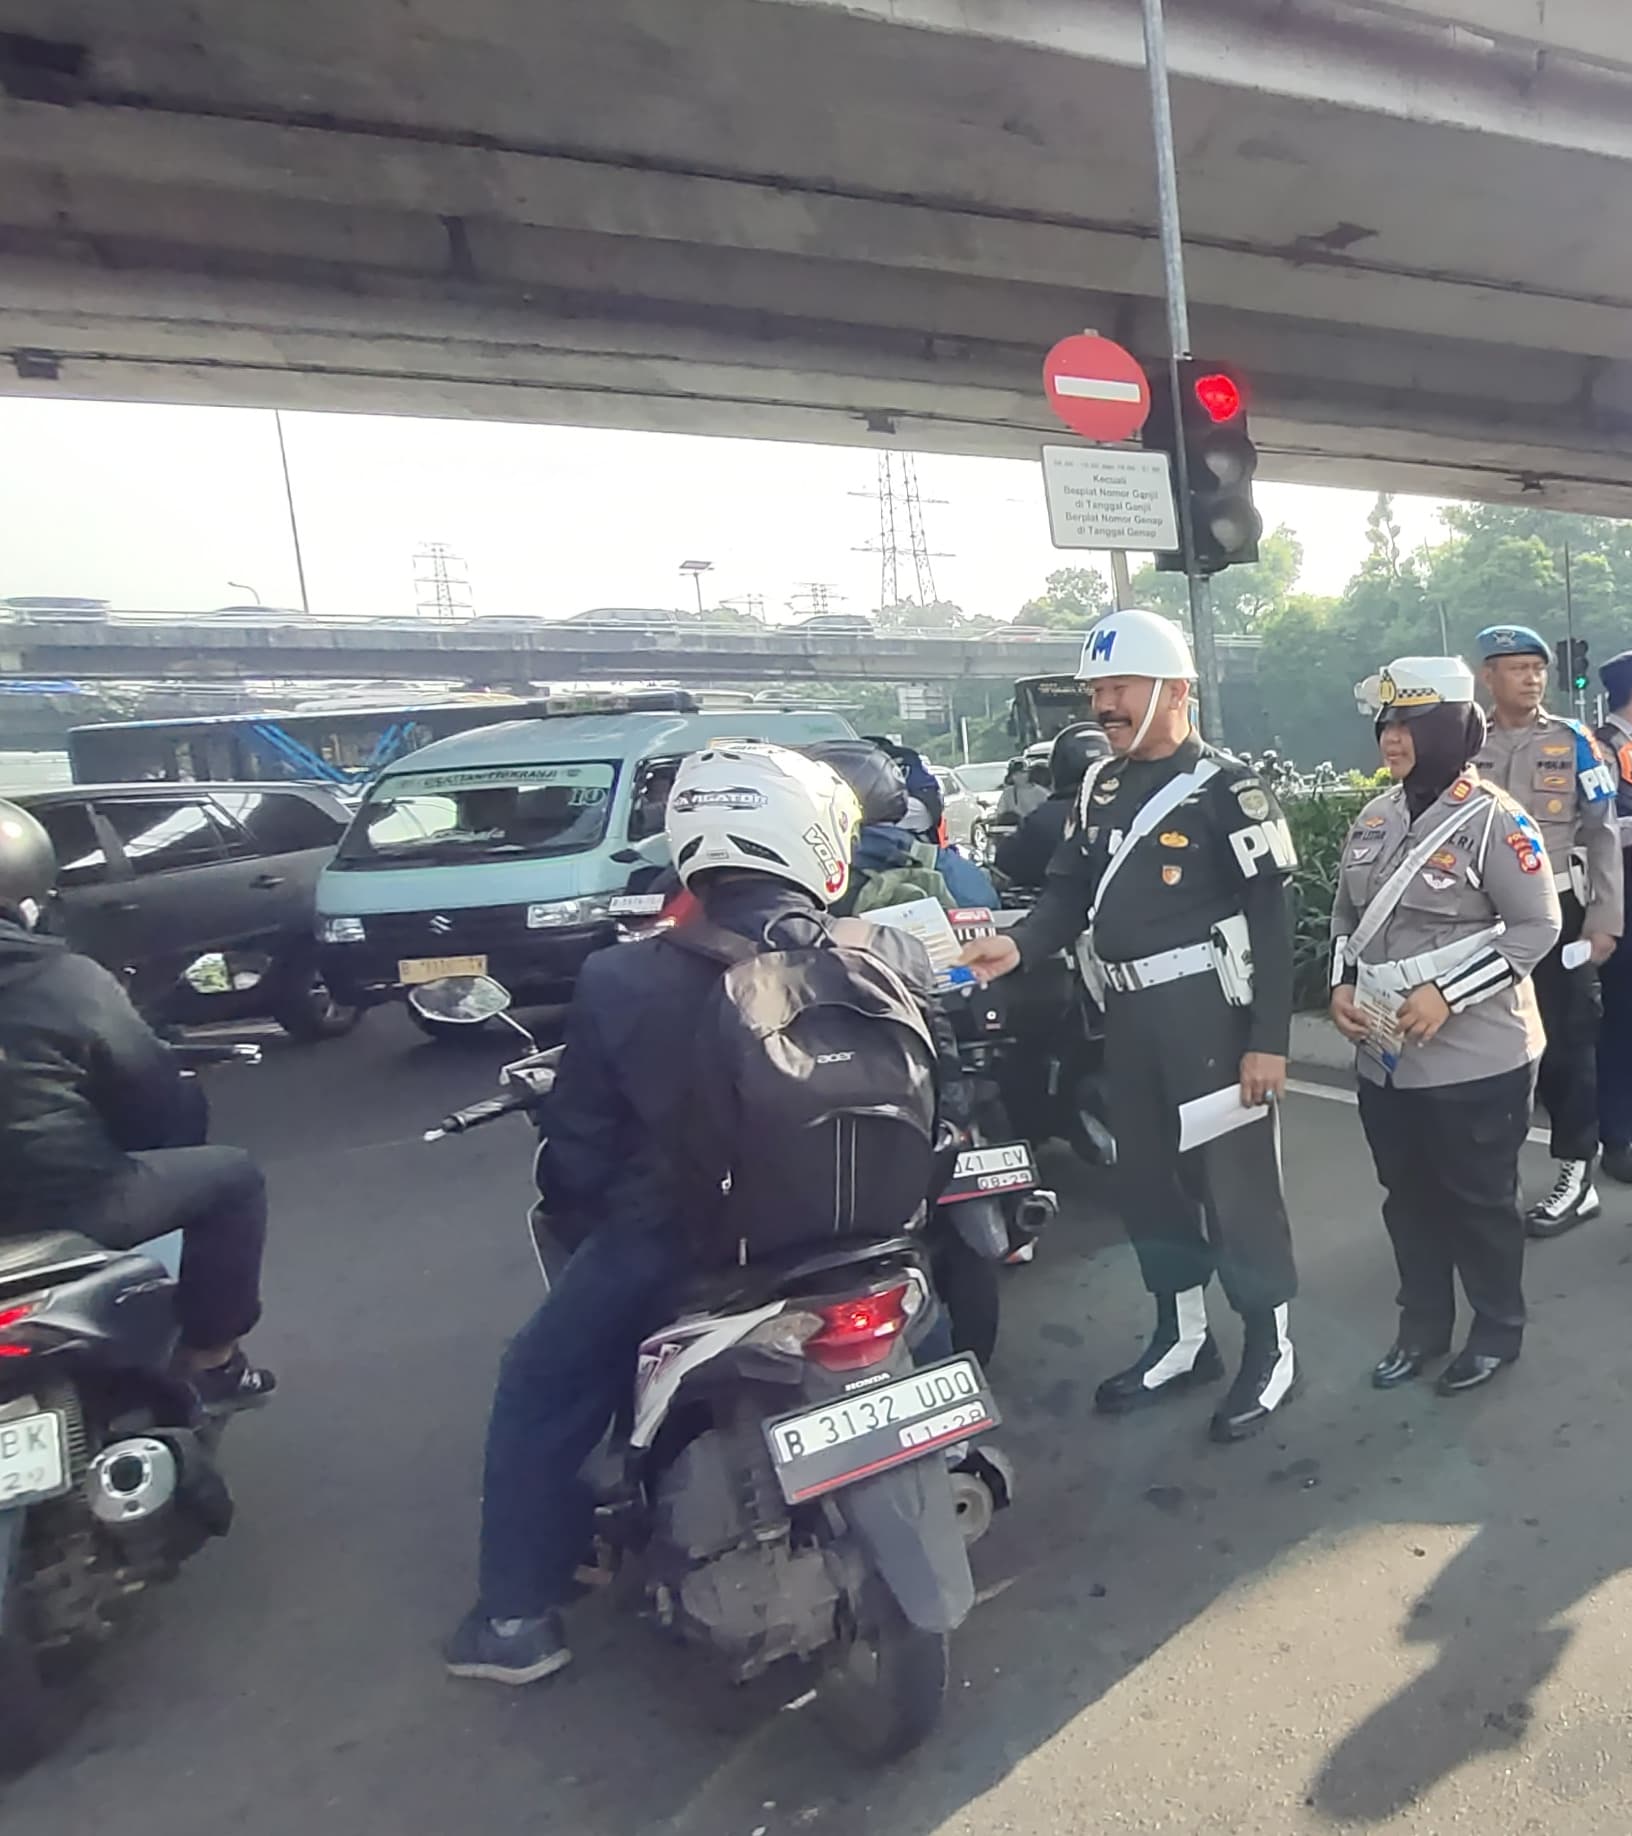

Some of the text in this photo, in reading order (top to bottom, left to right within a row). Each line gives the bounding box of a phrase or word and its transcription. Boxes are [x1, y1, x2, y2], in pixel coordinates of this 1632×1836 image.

[1579, 765, 1617, 800] PM
[1229, 818, 1298, 878] PM
[816, 1051, 856, 1063] acer
[845, 1371, 891, 1391] HONDA
[783, 1429, 806, 1456] B
[819, 1395, 900, 1446] 3132
